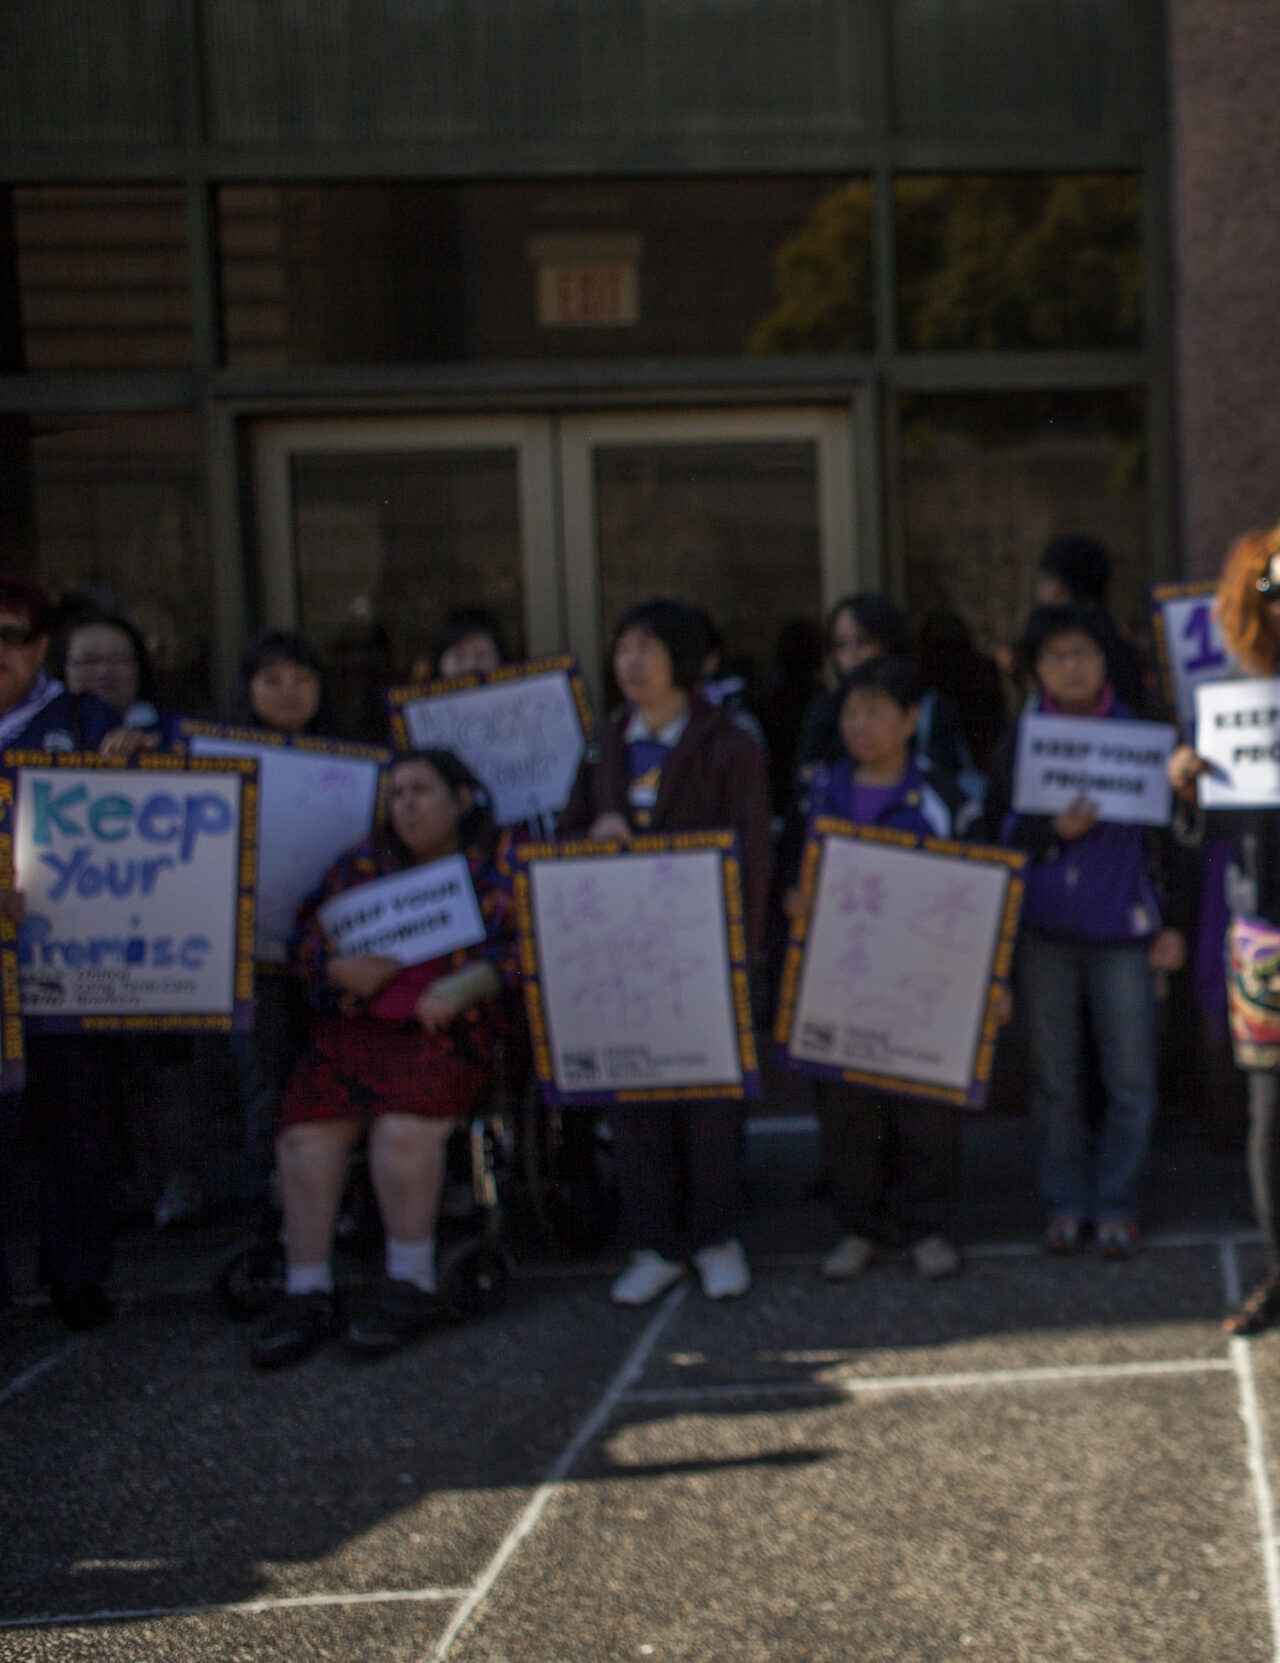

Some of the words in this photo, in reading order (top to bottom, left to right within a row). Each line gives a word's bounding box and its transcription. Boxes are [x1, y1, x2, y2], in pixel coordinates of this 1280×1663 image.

[1214, 707, 1280, 729] KEEP
[31, 779, 232, 863] Keep
[38, 848, 177, 901] Your
[19, 911, 212, 971] Promise
